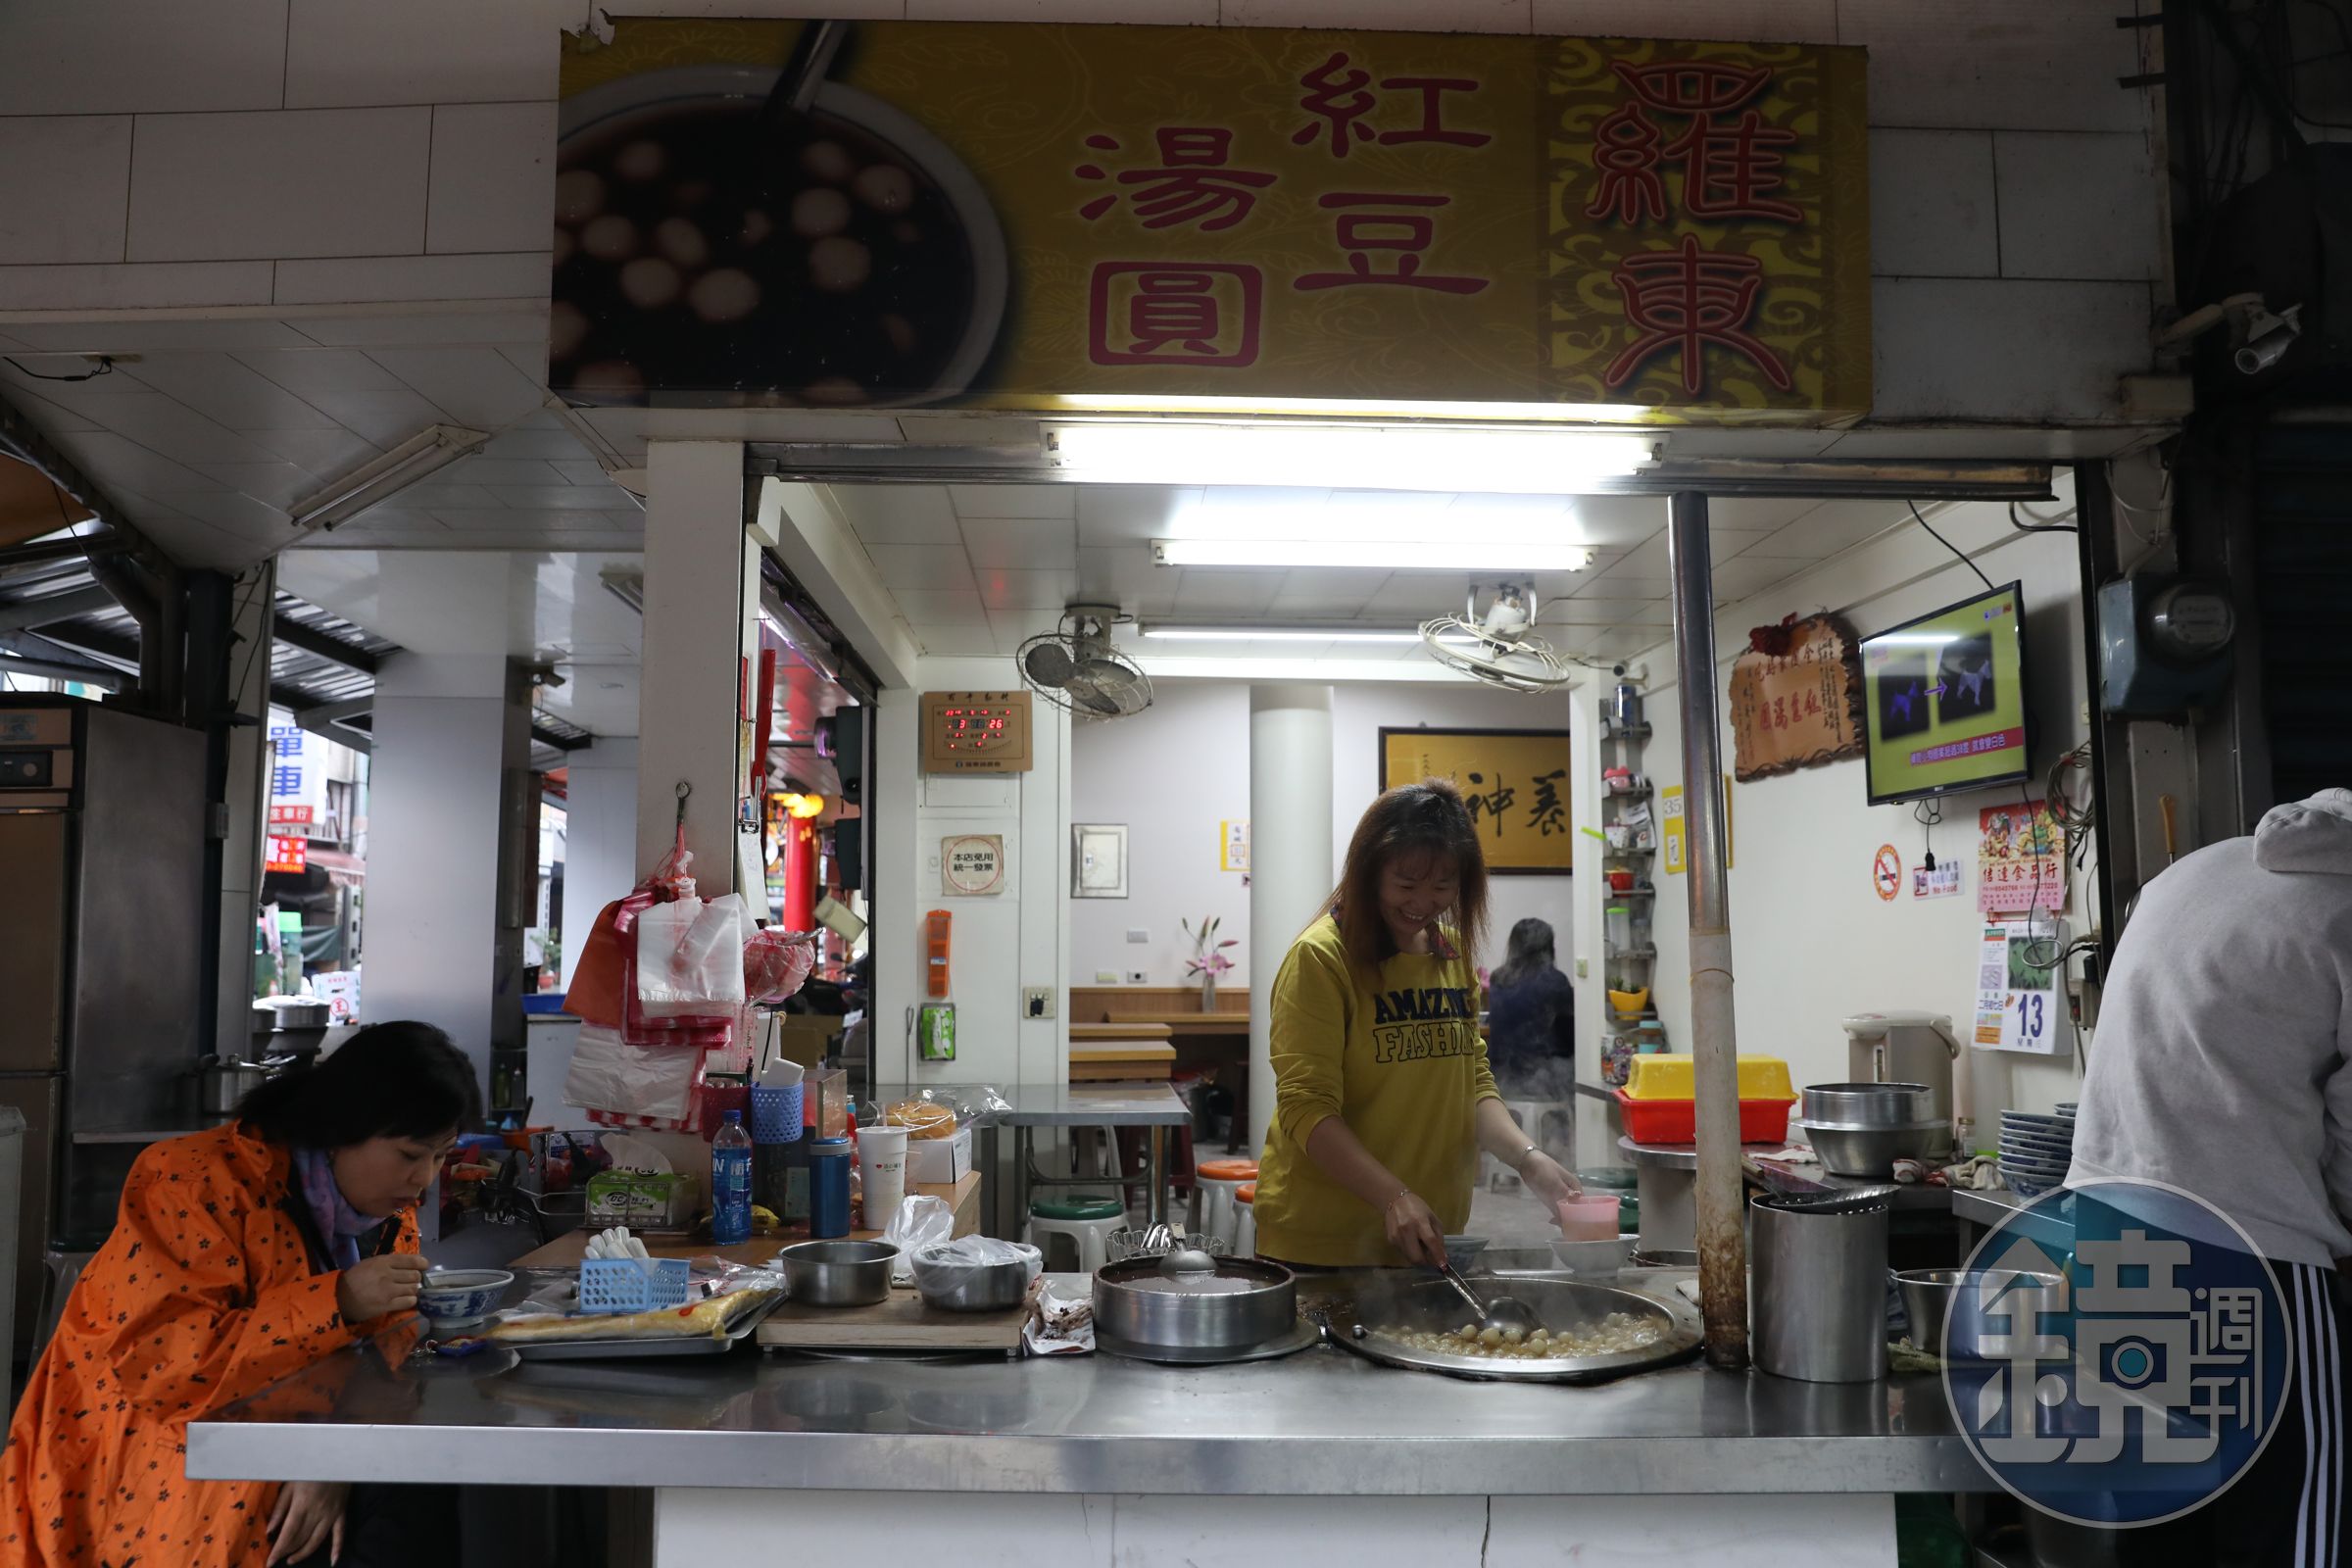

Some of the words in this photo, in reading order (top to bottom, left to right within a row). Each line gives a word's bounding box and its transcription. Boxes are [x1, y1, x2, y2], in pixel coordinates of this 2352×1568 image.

[1291, 51, 1493, 295] 紅豆
[1584, 59, 1806, 394] 羅東
[1073, 125, 1279, 368] 湯圓
[954, 853, 994, 861] 本店免用
[954, 863, 994, 872] 統一發票
[2018, 994, 2043, 1038] 13
